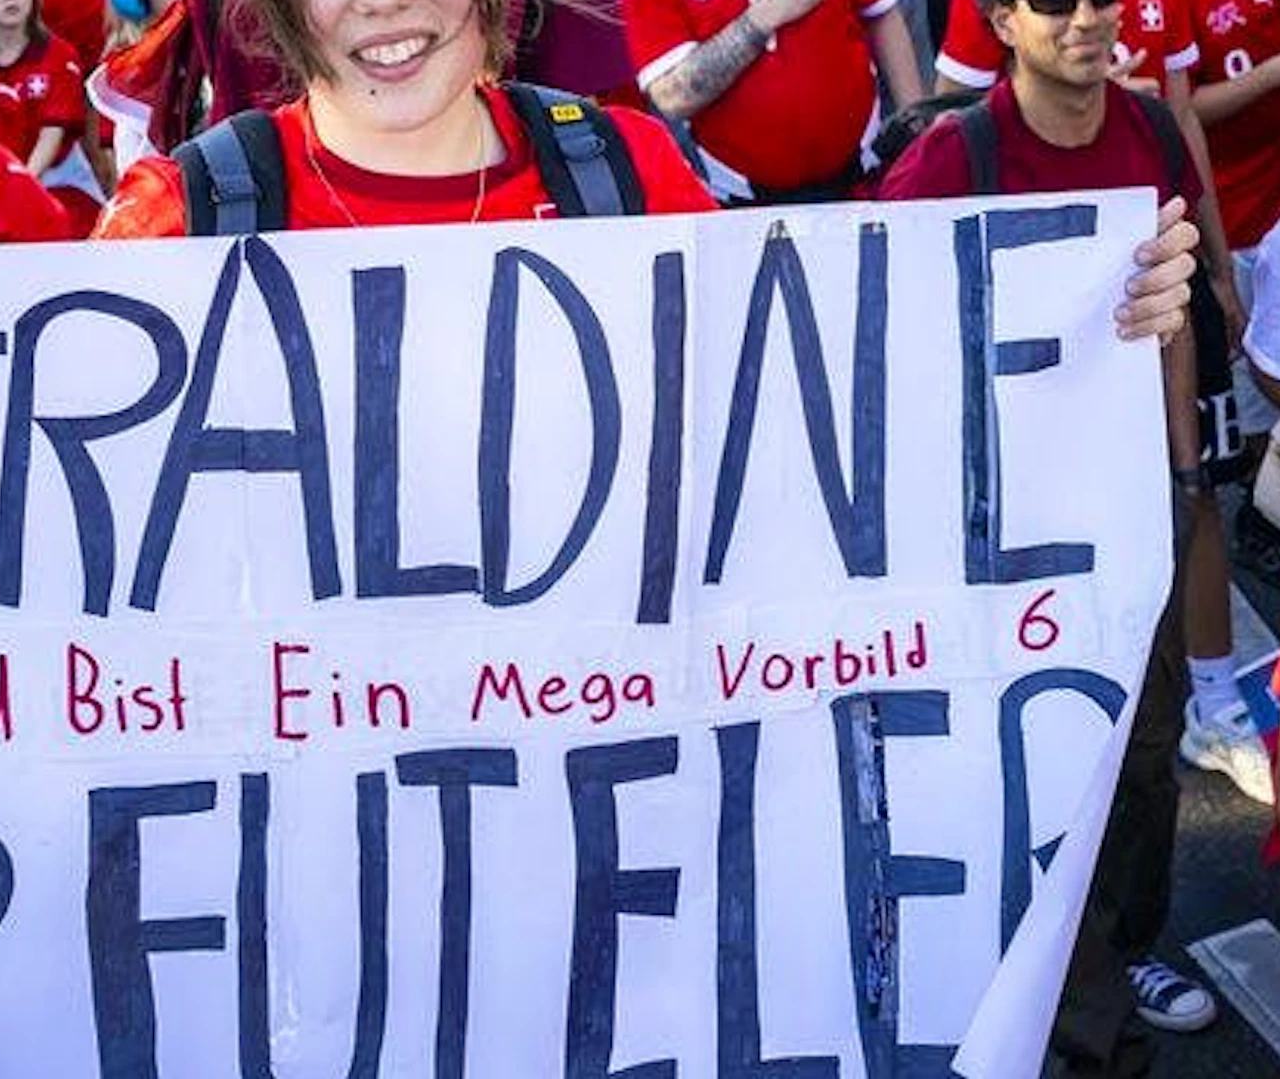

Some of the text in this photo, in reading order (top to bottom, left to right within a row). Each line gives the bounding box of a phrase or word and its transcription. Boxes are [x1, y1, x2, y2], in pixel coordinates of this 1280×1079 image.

[67, 643, 185, 734] Bist
[273, 642, 411, 741] Ein
[470, 662, 655, 724] Mega
[717, 622, 928, 699] Vorbild
[1019, 589, 1060, 652] 6
